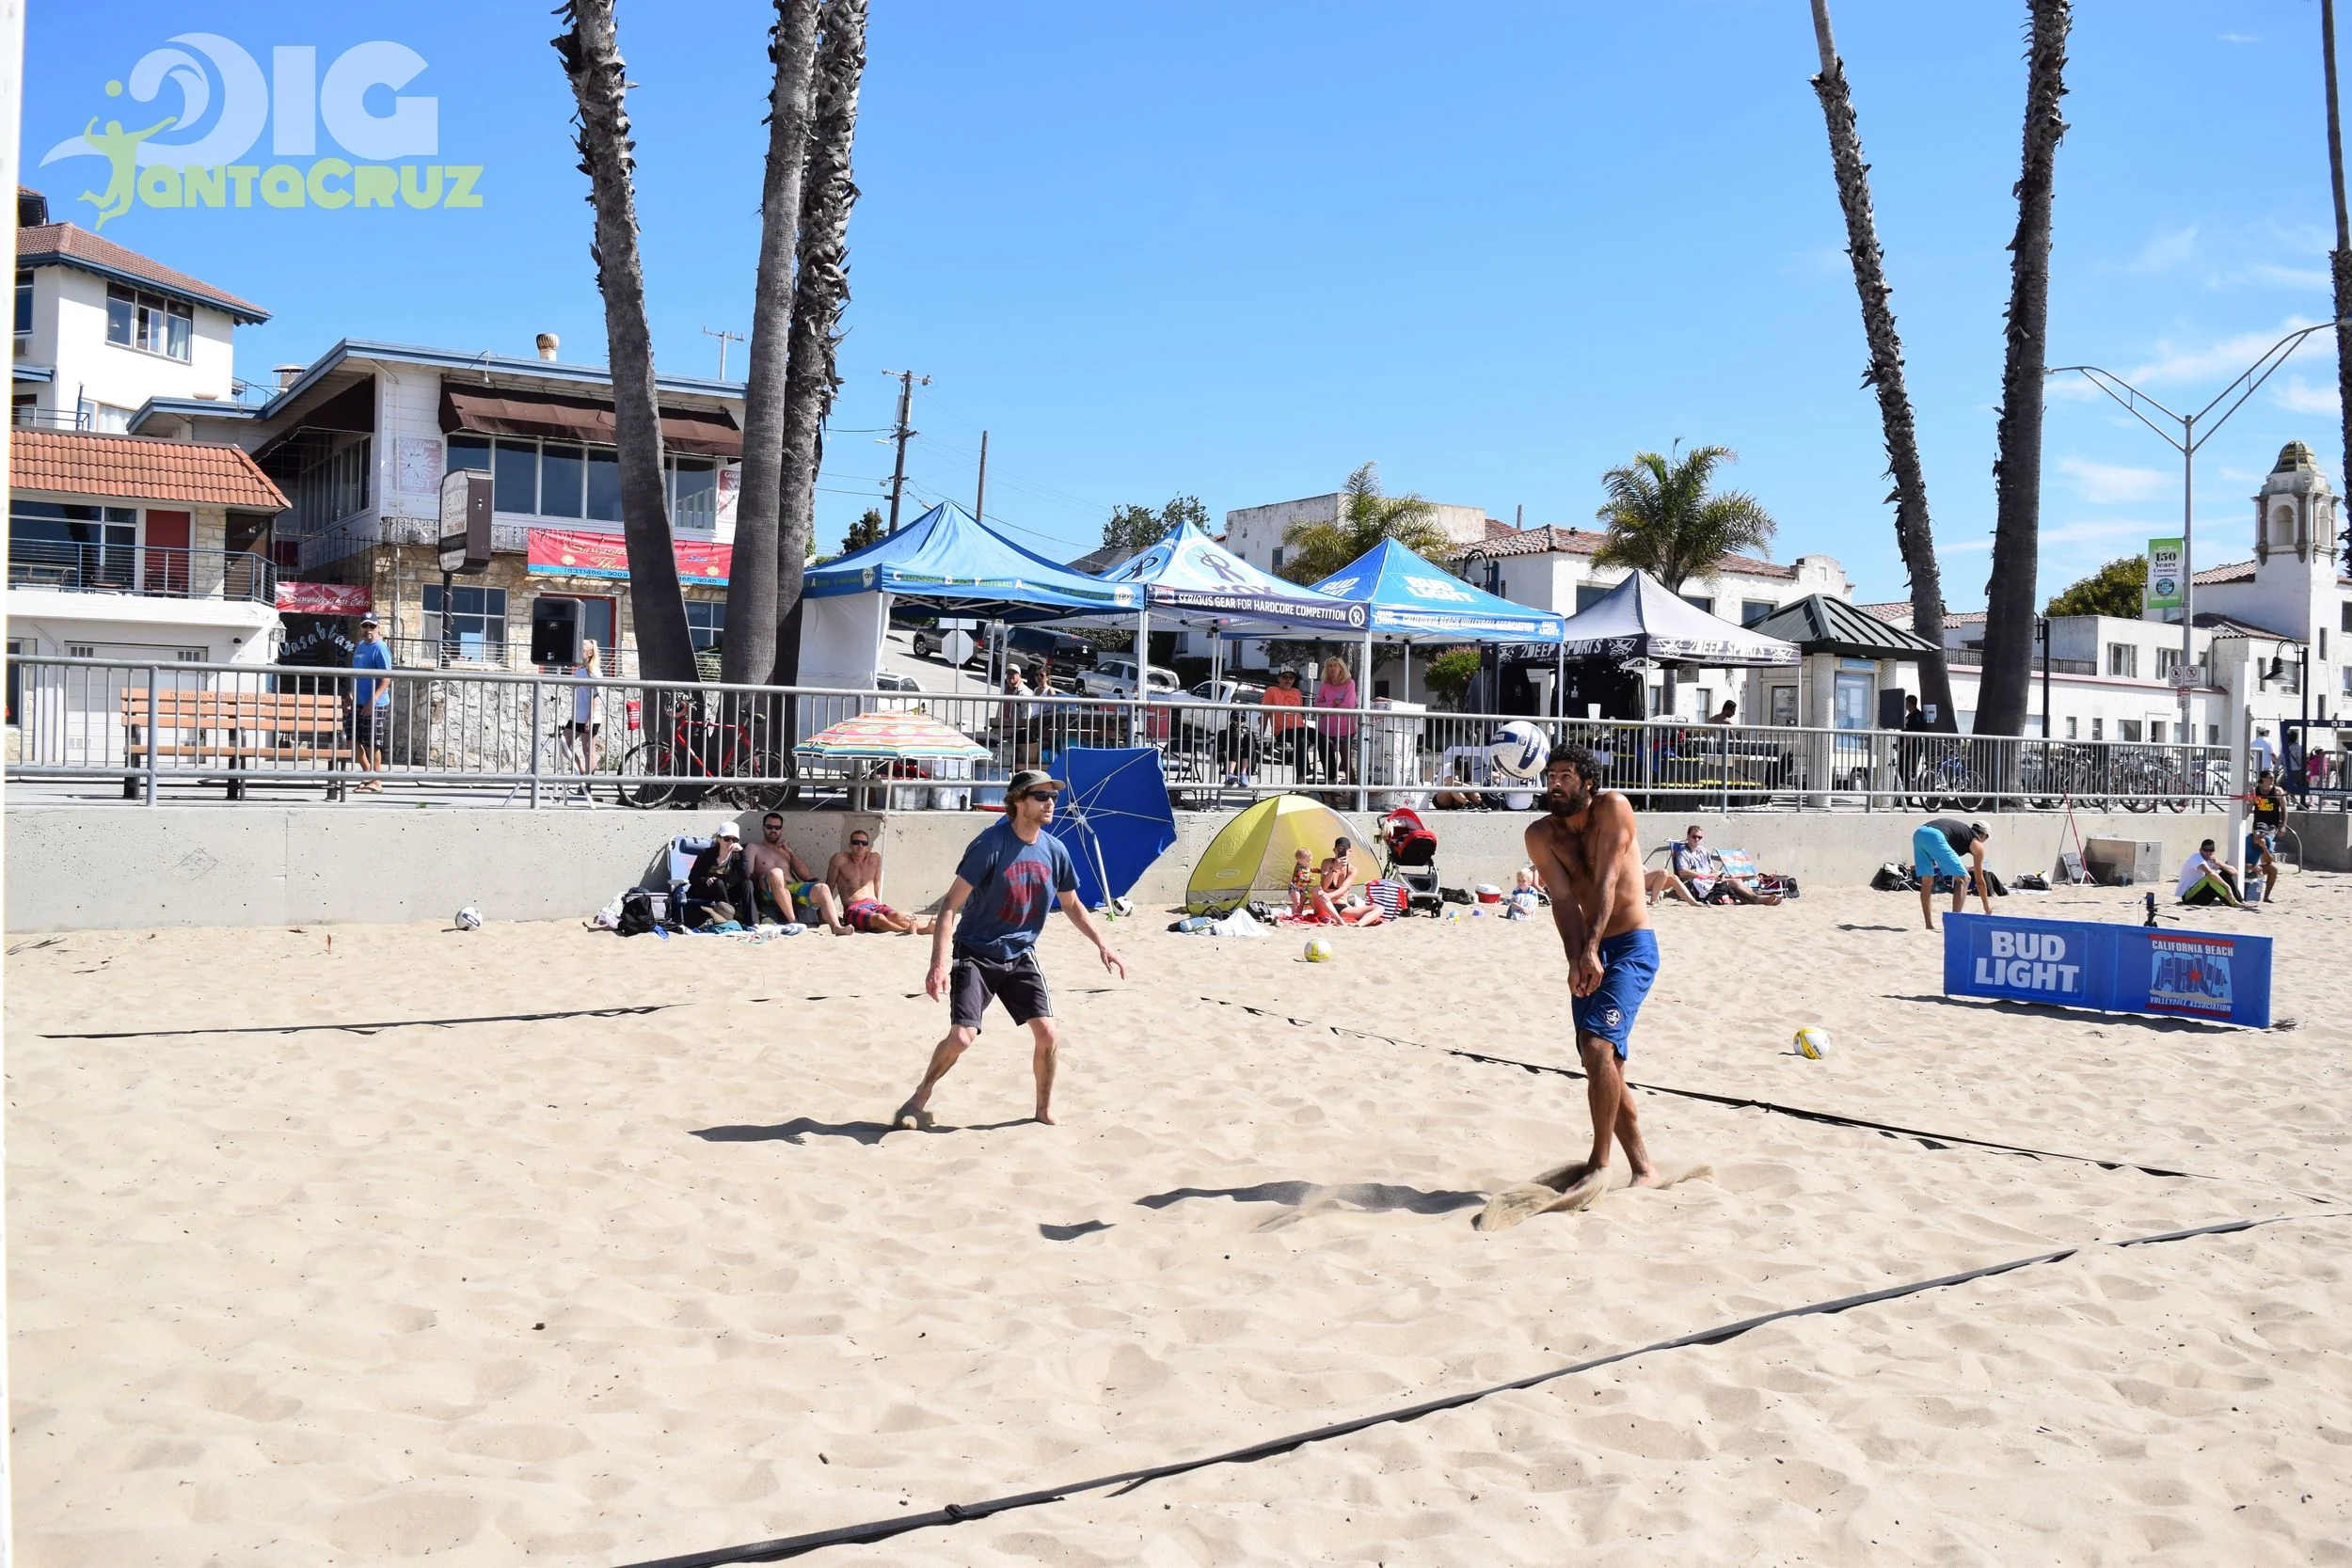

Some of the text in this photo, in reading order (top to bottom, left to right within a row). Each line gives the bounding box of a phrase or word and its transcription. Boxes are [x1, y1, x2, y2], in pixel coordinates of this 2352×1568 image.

[2155, 552, 2177, 562] 150
[1403, 576, 1455, 592] BUD
[1178, 593, 1215, 607] SERIOUS
[1215, 596, 1236, 609] GEAR
[1237, 598, 1253, 610] FOR
[1253, 599, 1295, 616] HARDCORE
[1295, 605, 1347, 622] COMPETITION
[1538, 627, 1560, 637] LIGHT
[1519, 643, 1556, 658] 2DEEP
[1689, 640, 1723, 655] 2DEEP
[1991, 930, 2066, 962] BUD
[2152, 940, 2233, 957] CALIFORNIA BEACH
[1975, 958, 2079, 992] LIGHT
[2150, 995, 2232, 1012] VOLLEYBALL ASSOCIATION
